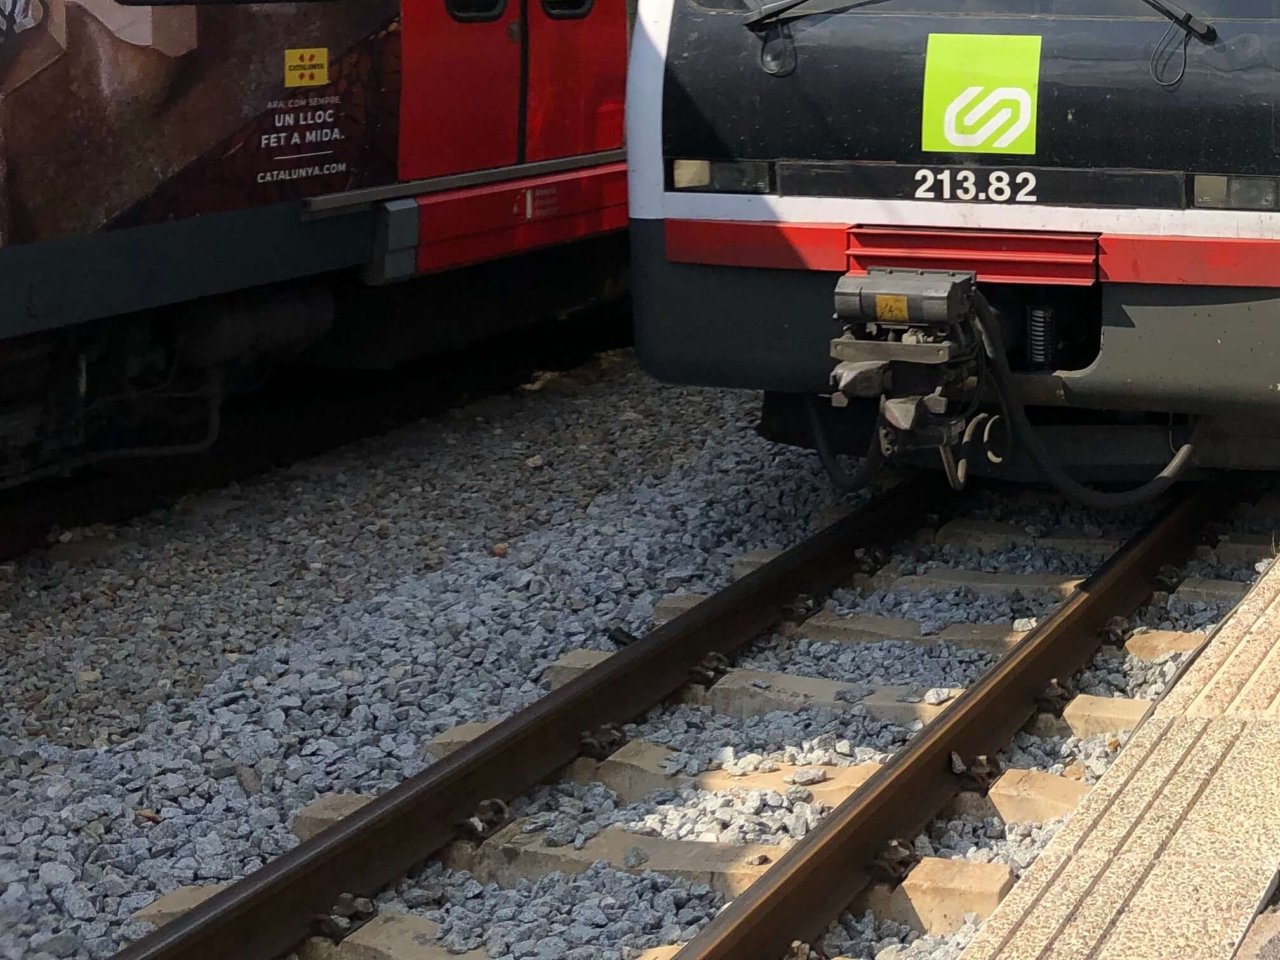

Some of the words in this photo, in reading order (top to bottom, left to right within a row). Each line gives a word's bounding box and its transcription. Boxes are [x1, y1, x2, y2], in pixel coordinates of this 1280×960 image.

[288, 63, 325, 71] CATALUNYA
[288, 99, 306, 108] COM
[275, 114, 295, 127] UN
[299, 110, 335, 125] LLOC
[261, 133, 288, 148] FET
[291, 132, 301, 145] A
[305, 127, 345, 143] MIDA.
[257, 163, 347, 183] CATALUNYA.COM
[914, 168, 1037, 202] 213.82
